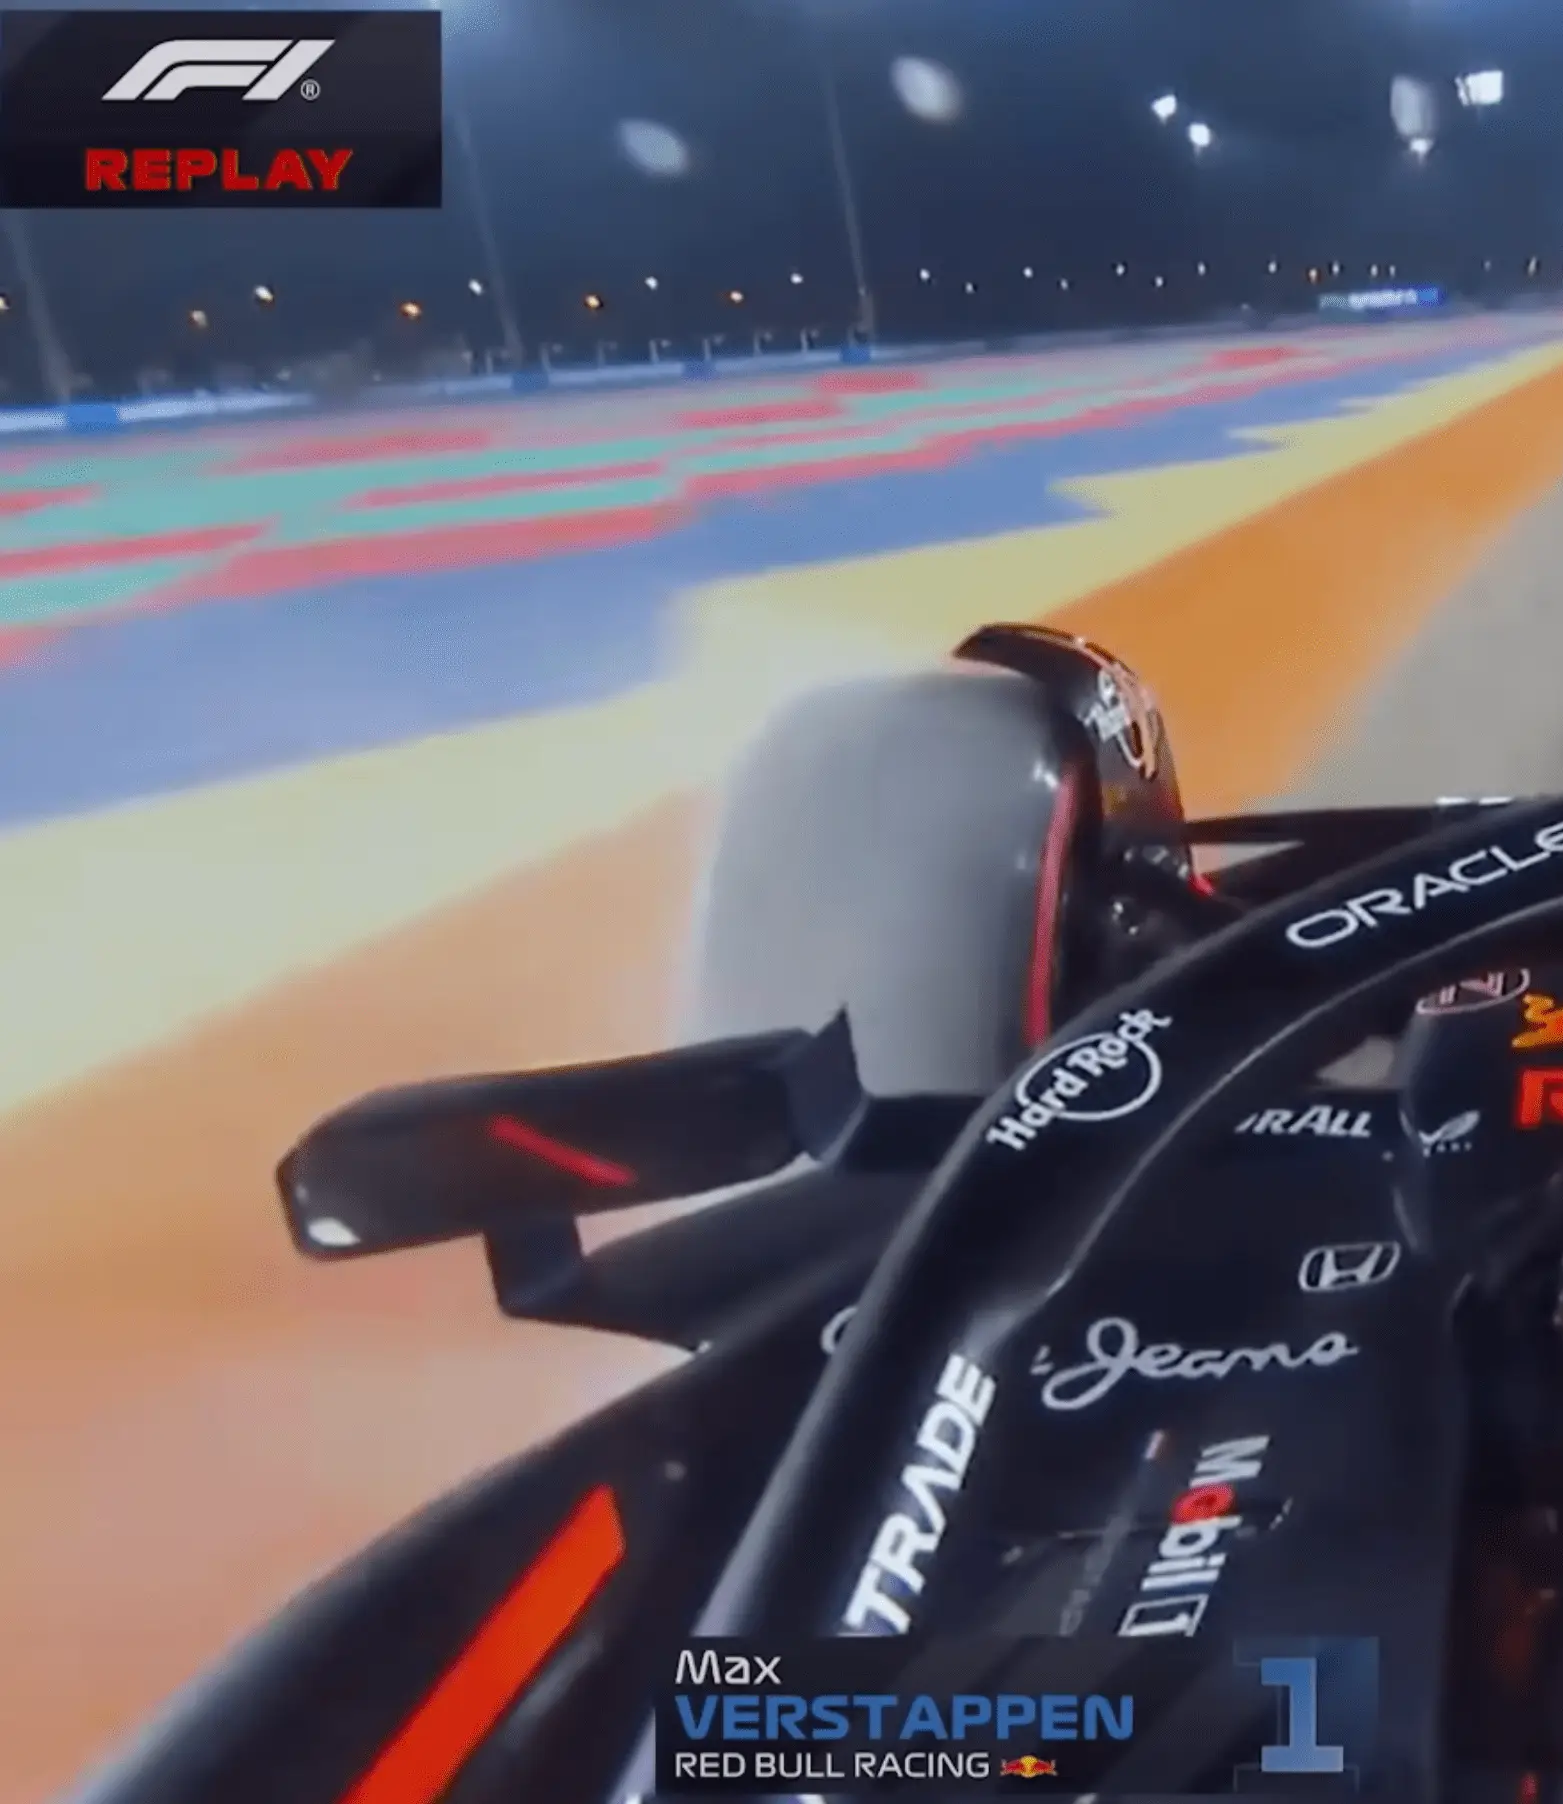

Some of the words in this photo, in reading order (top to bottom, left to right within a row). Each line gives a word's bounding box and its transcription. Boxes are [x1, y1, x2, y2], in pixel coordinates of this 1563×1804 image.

[985, 1067, 1089, 1151] Hard
[1066, 1009, 1173, 1077] Rock
[1041, 1317, 1361, 1411] Jeans
[842, 1352, 997, 1635] TRADE
[1140, 1434, 1271, 1592] Mobil
